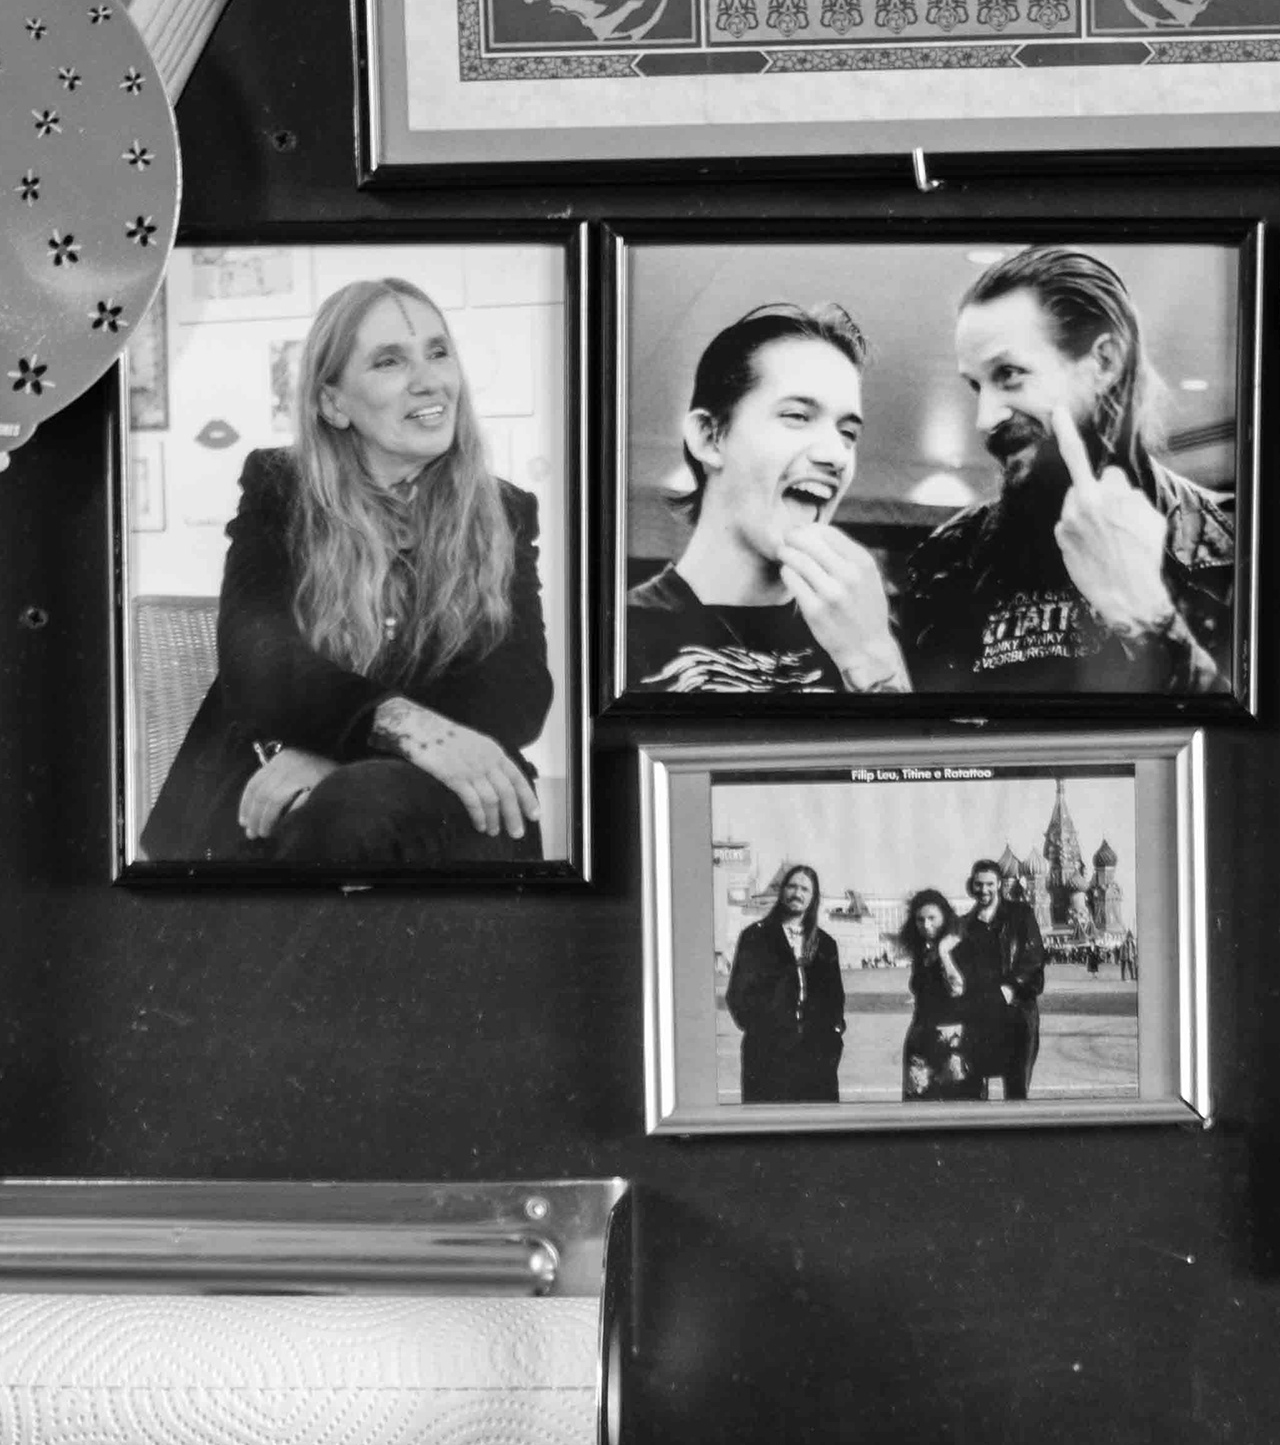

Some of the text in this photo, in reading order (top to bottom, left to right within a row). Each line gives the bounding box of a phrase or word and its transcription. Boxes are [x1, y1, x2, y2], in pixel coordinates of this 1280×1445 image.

[851, 768, 874, 783] Filip
[876, 769, 900, 781] Leu,
[902, 768, 932, 780] Titine
